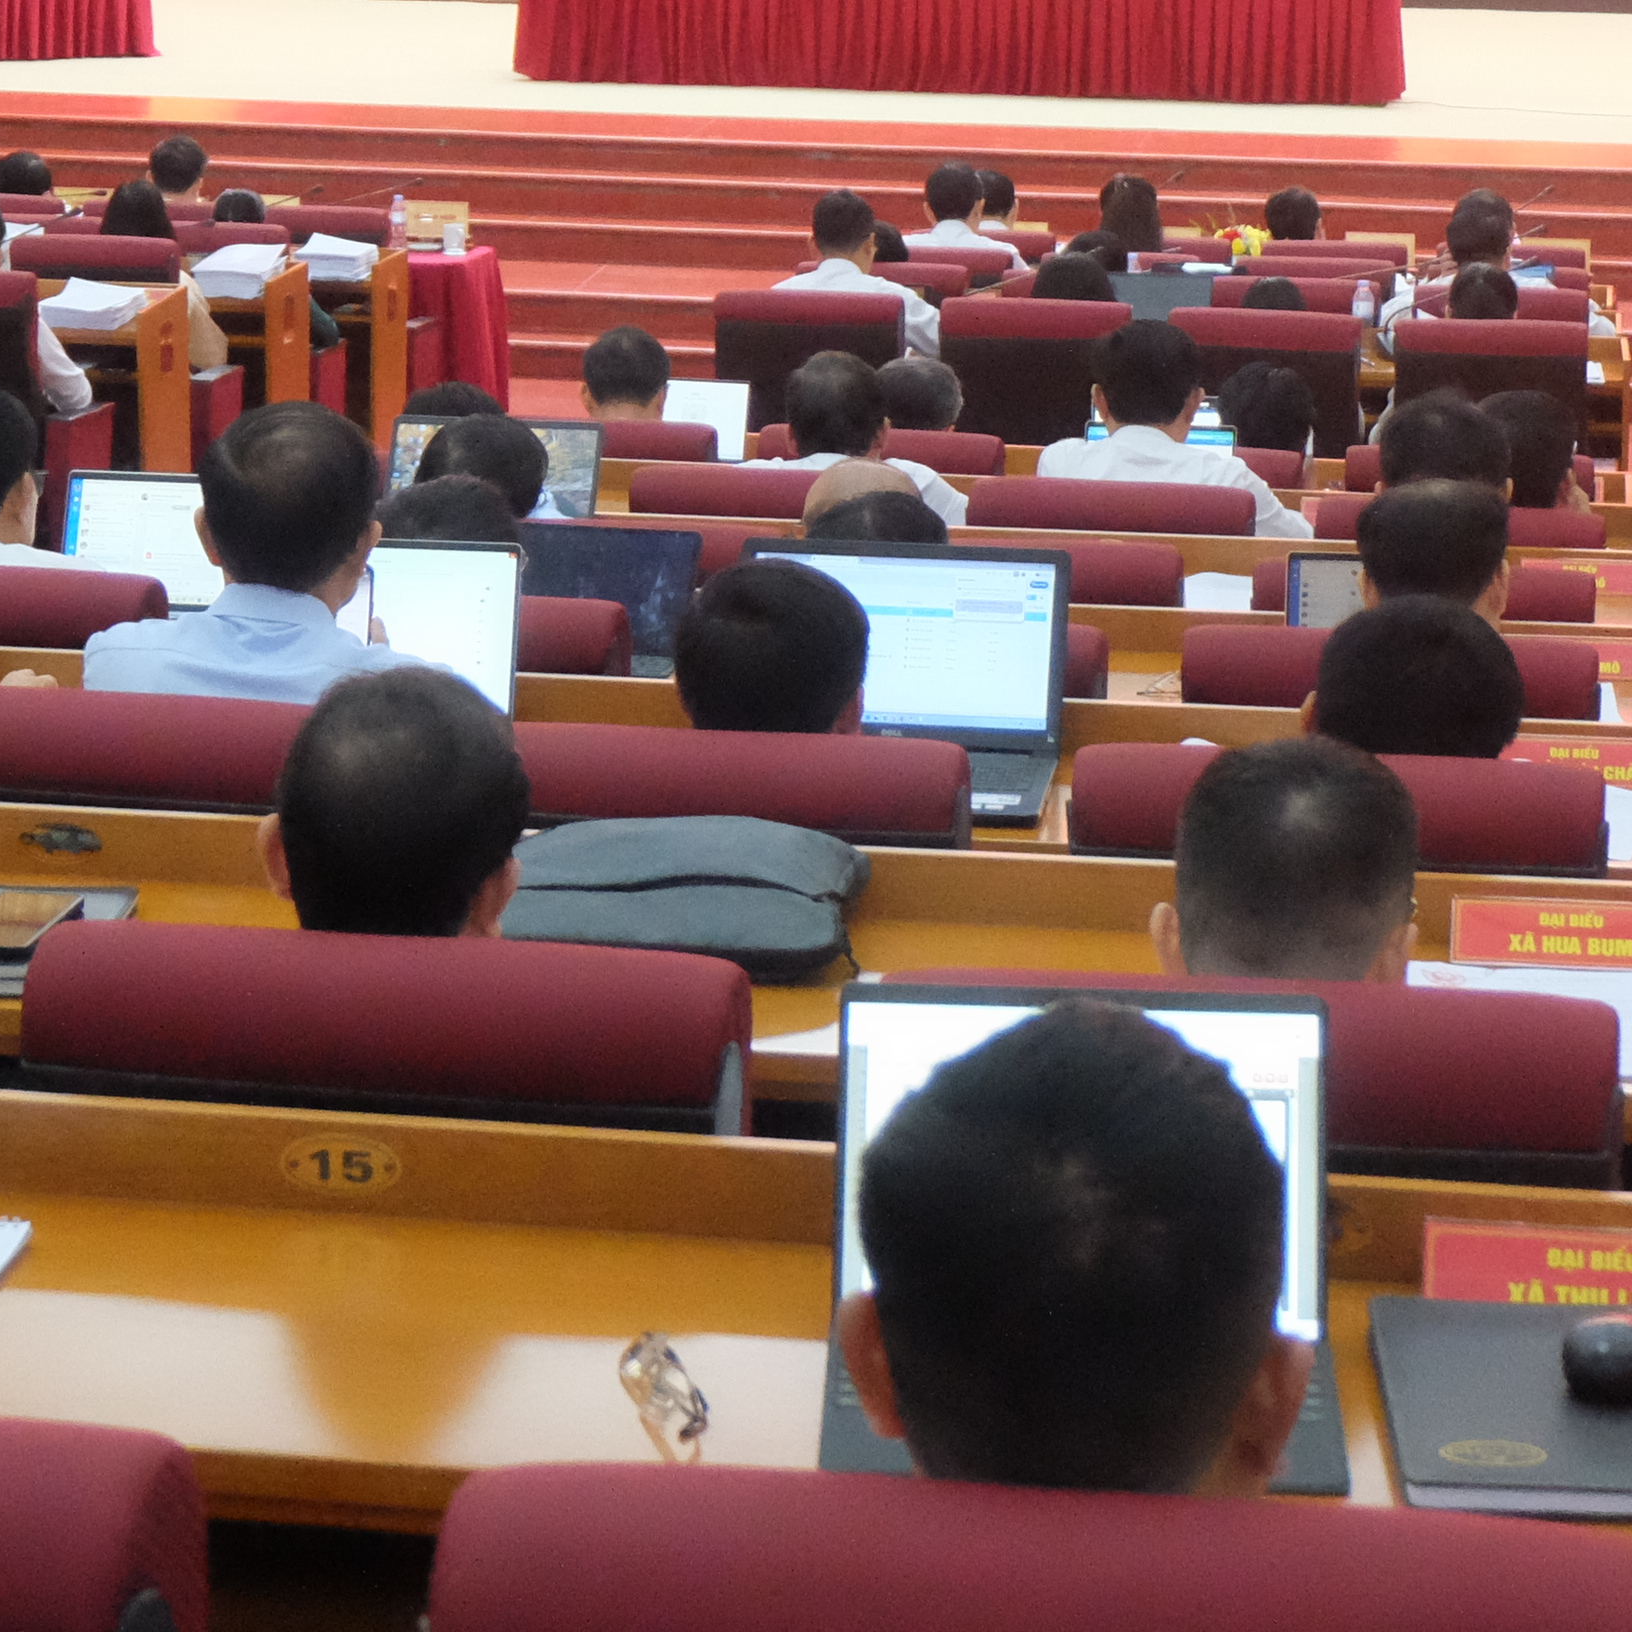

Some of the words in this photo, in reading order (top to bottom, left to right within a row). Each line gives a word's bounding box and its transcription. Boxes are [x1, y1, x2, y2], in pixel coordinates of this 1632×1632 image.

[1549, 746, 1570, 760] ĐẠI
[1572, 744, 1600, 760] BIỂU
[1539, 912, 1566, 929] ĐẠI
[1569, 909, 1605, 929] BIỂU
[1509, 931, 1537, 953] XÃ
[1542, 934, 1583, 955] HUA
[310, 1149, 373, 1183] 15
[1546, 1247, 1585, 1272] ĐẠI
[1508, 1278, 1545, 1304] XÃ
